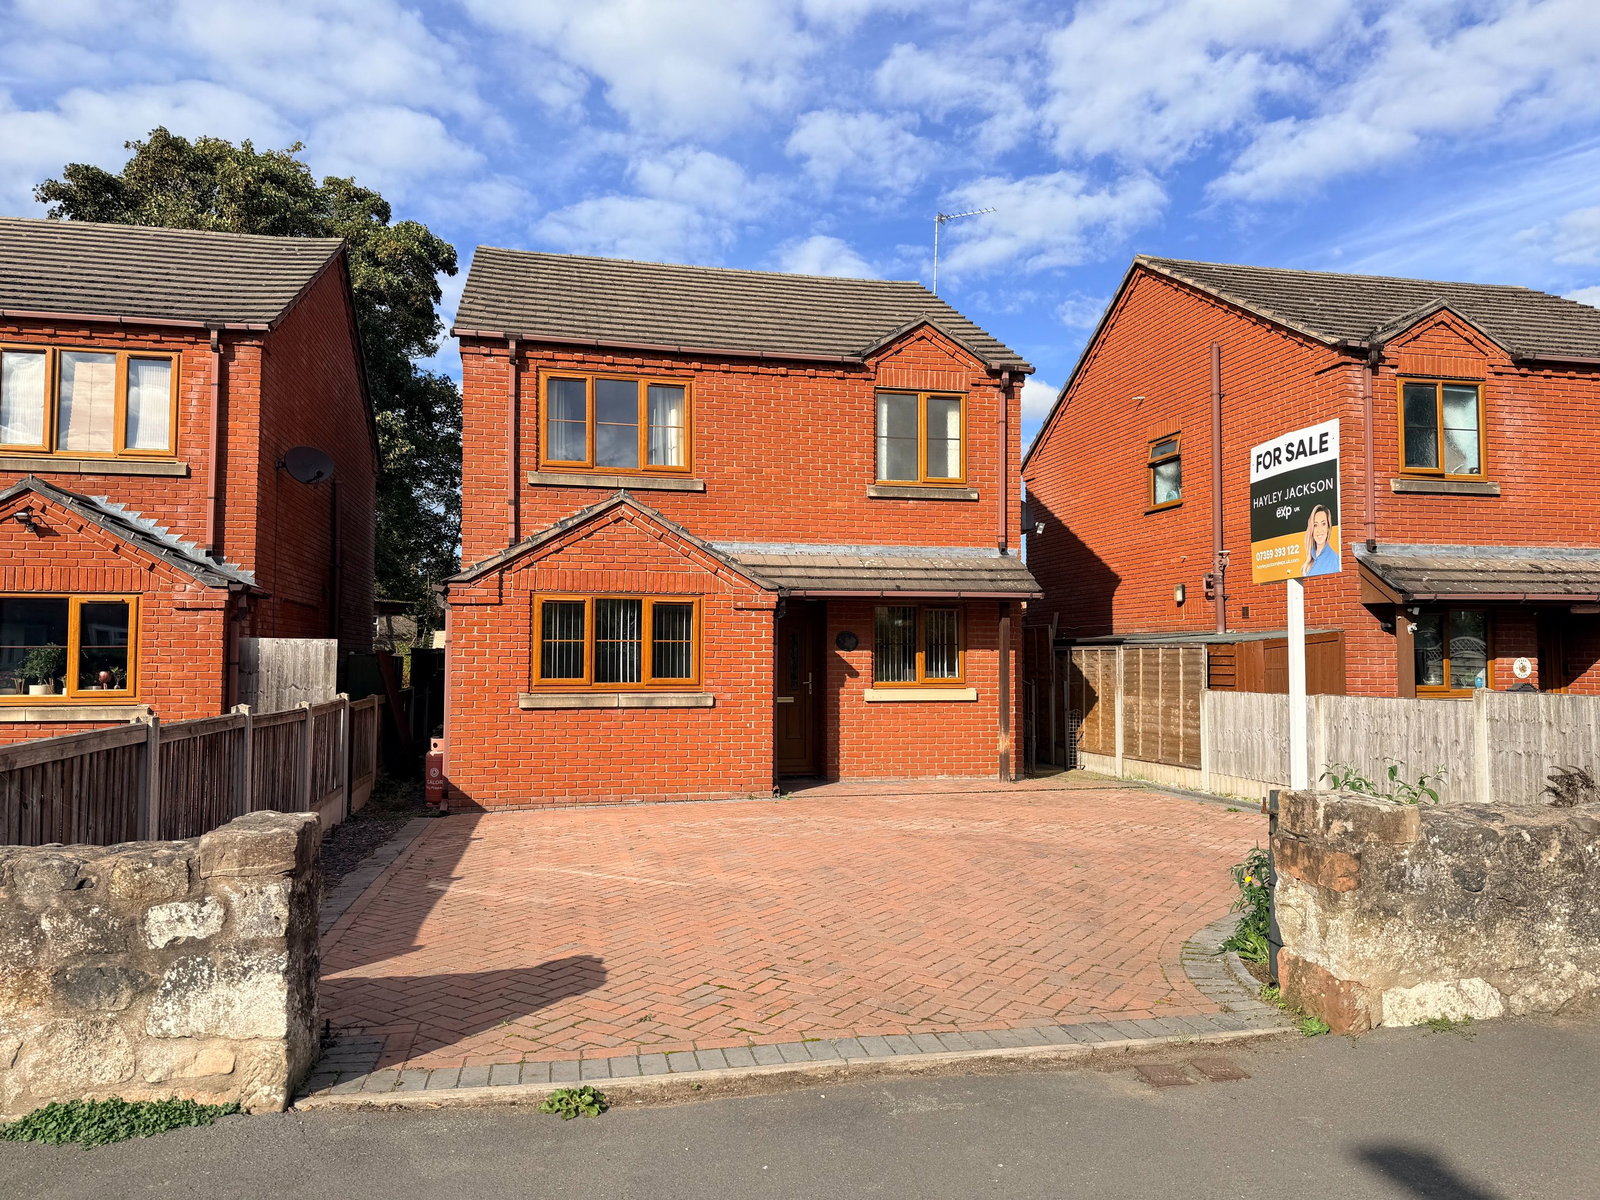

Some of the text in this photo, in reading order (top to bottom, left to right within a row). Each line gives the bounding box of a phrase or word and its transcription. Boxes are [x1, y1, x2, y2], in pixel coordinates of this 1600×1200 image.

[1256, 432, 1329, 473] FOR SALE
[1253, 477, 1334, 509] HAYLEY JACKSON
[1256, 544, 1300, 562] 07359 393 122
